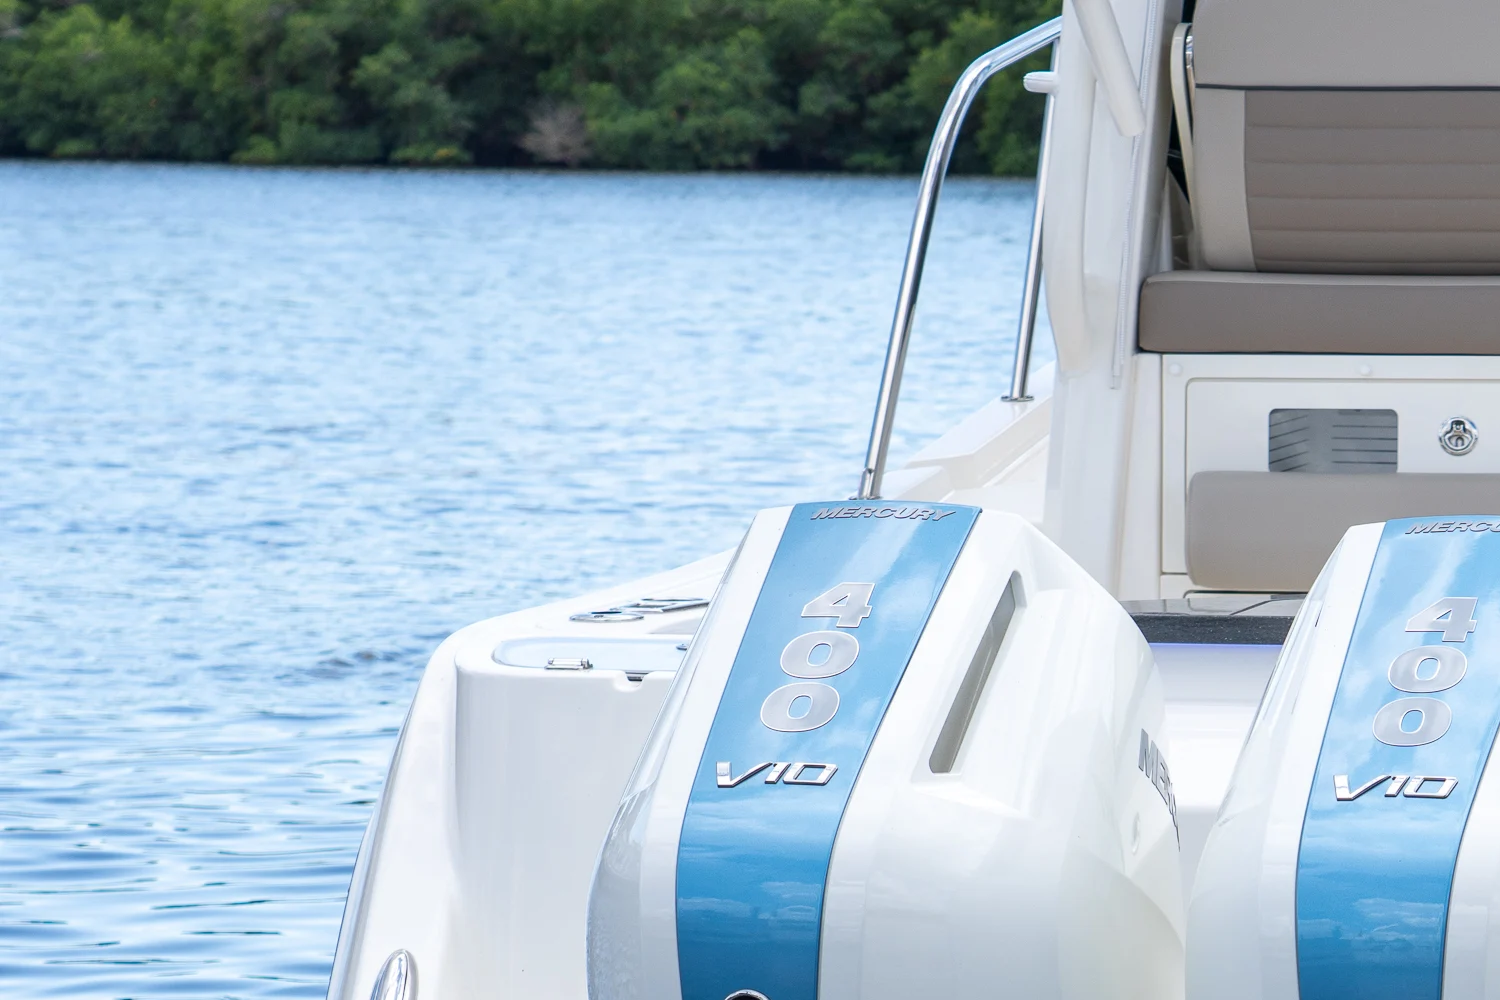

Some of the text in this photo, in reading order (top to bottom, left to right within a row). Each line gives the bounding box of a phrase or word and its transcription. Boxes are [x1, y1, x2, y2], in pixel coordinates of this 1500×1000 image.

[810, 506, 956, 521] MERCURY
[760, 582, 875, 732] 400
[1372, 597, 1478, 747] 400
[716, 761, 838, 788] V10
[1333, 774, 1458, 801] V10
